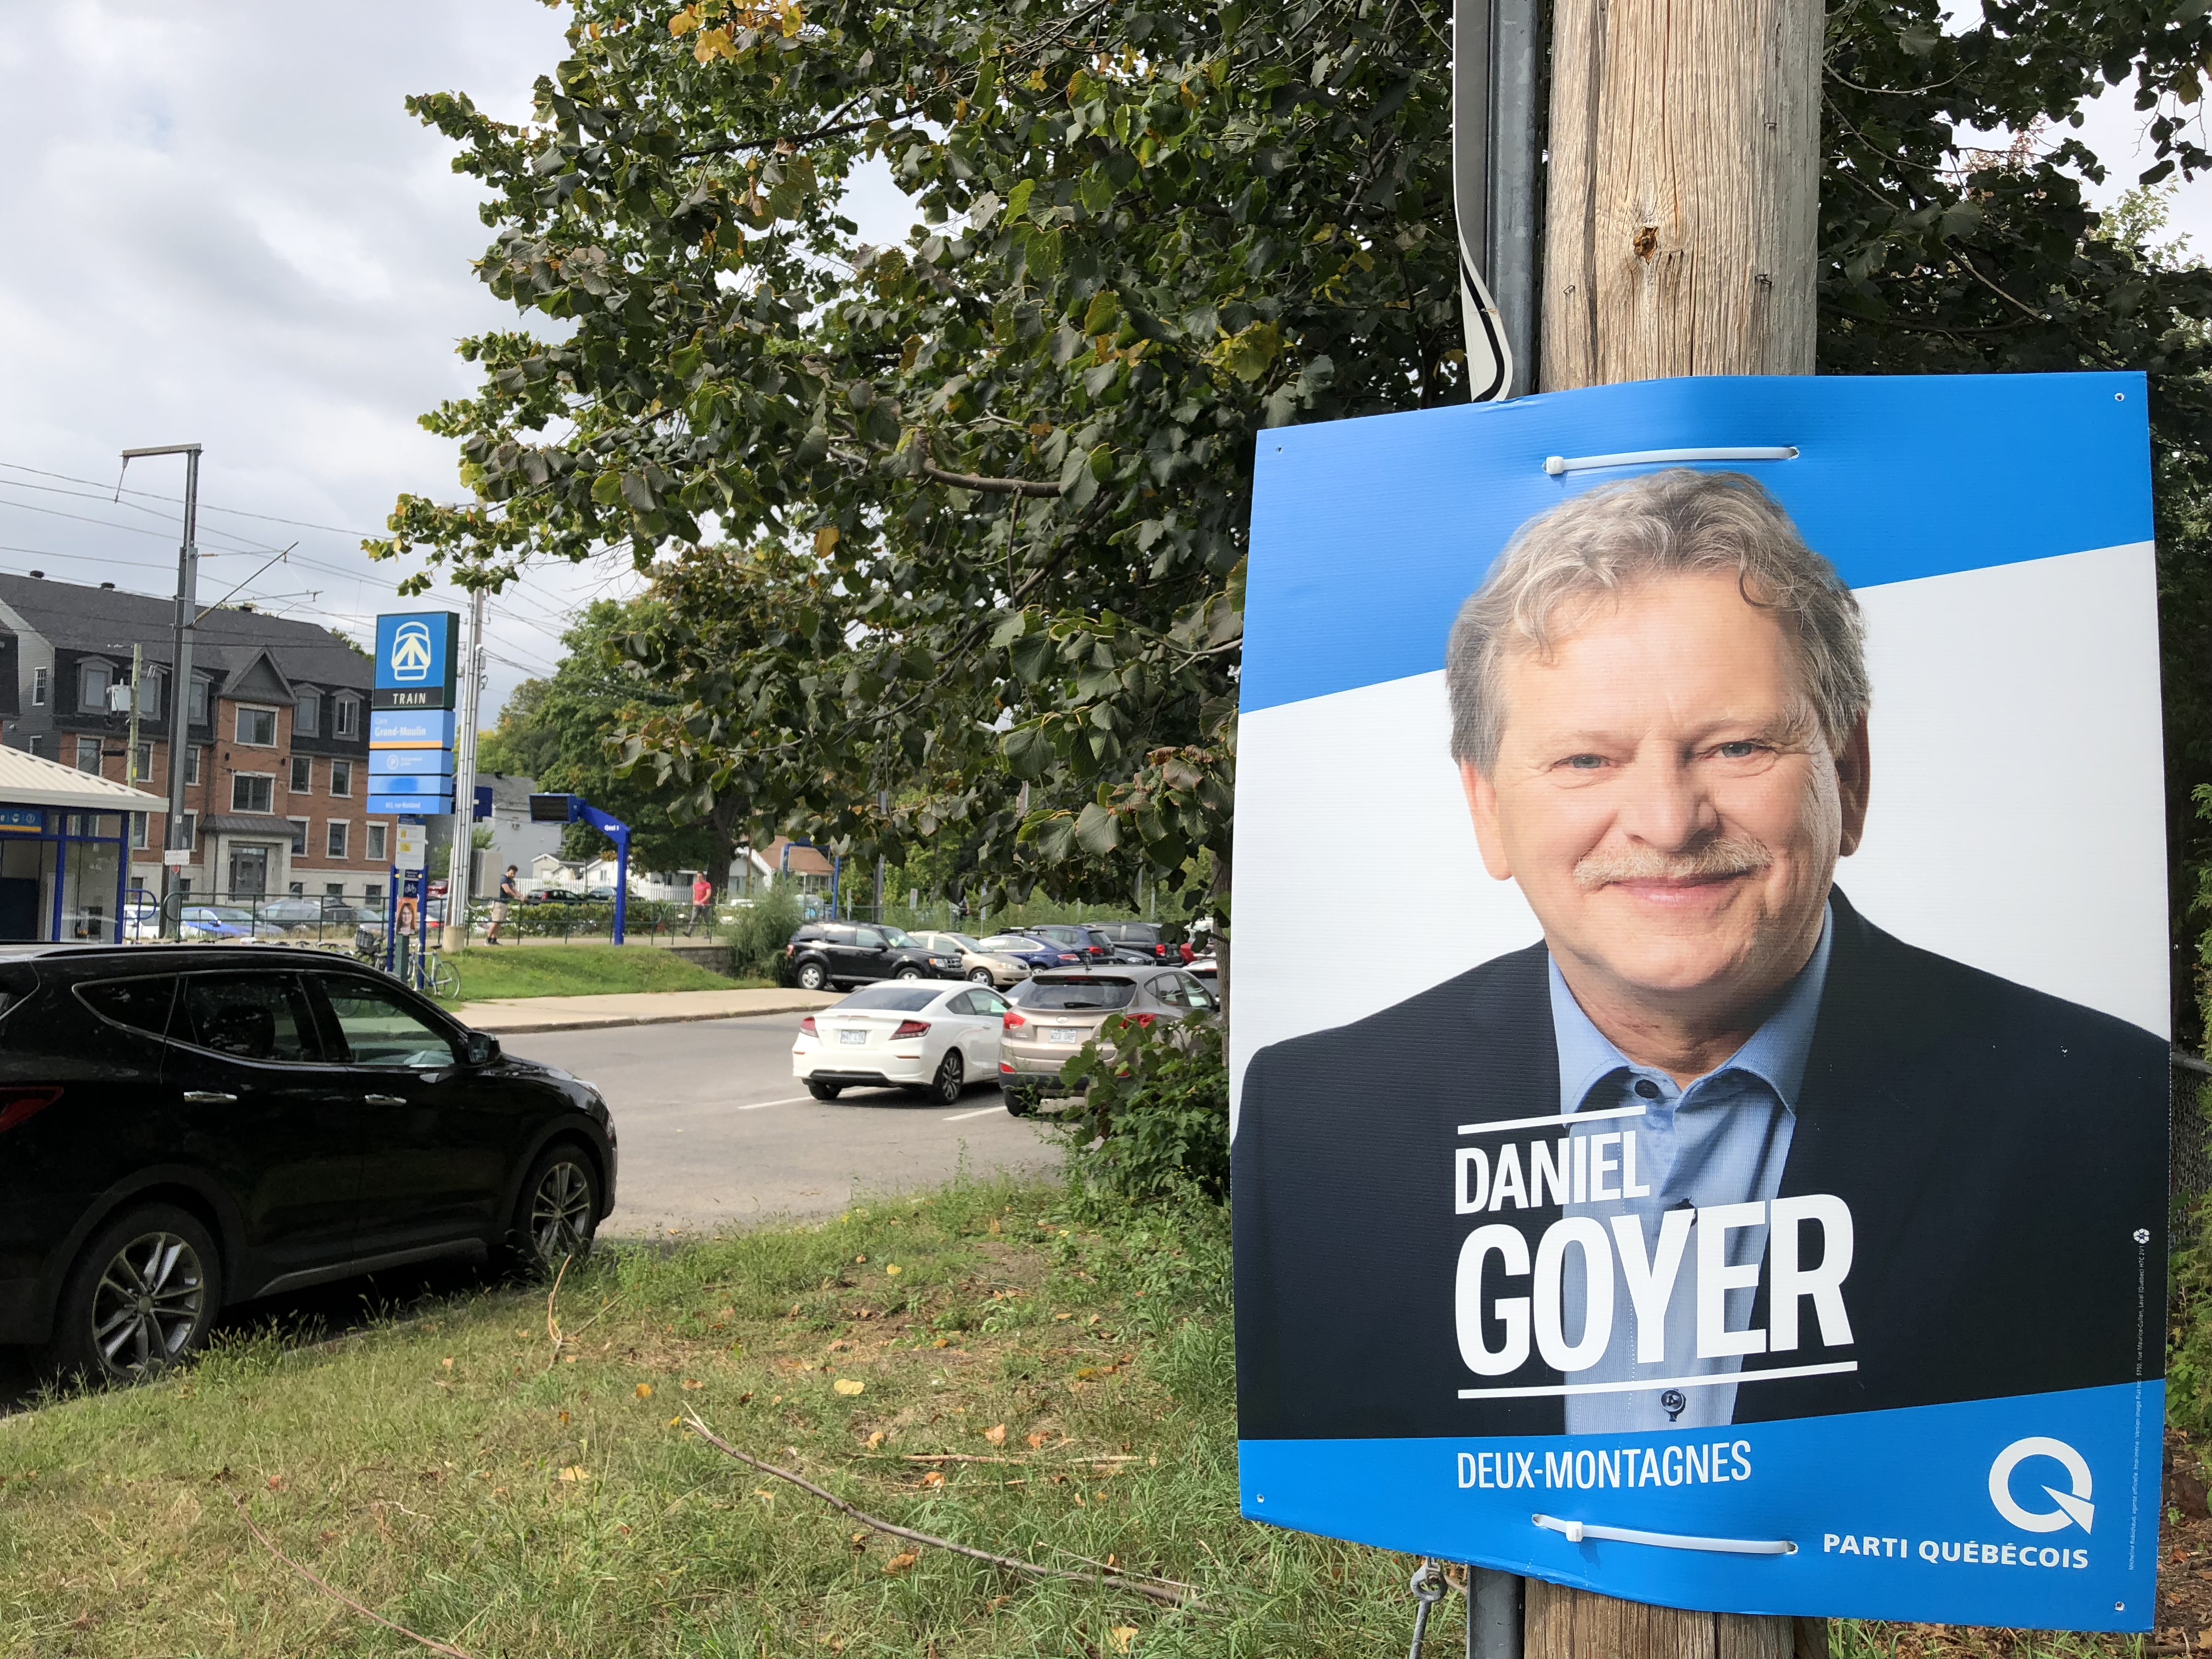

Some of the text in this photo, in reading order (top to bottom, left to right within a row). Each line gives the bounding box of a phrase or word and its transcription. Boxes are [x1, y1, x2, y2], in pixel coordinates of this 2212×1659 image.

[393, 692, 426, 705] TRAIN
[375, 726, 426, 737] Grand-Moulin
[1455, 1130, 1650, 1215] DANIEL
[1455, 1194, 1854, 1375] GOYER
[1458, 1440, 1751, 1488] DEUX-MONTAGNES
[1824, 1533, 2089, 1569] PARTI QUÉBÉCOIS
